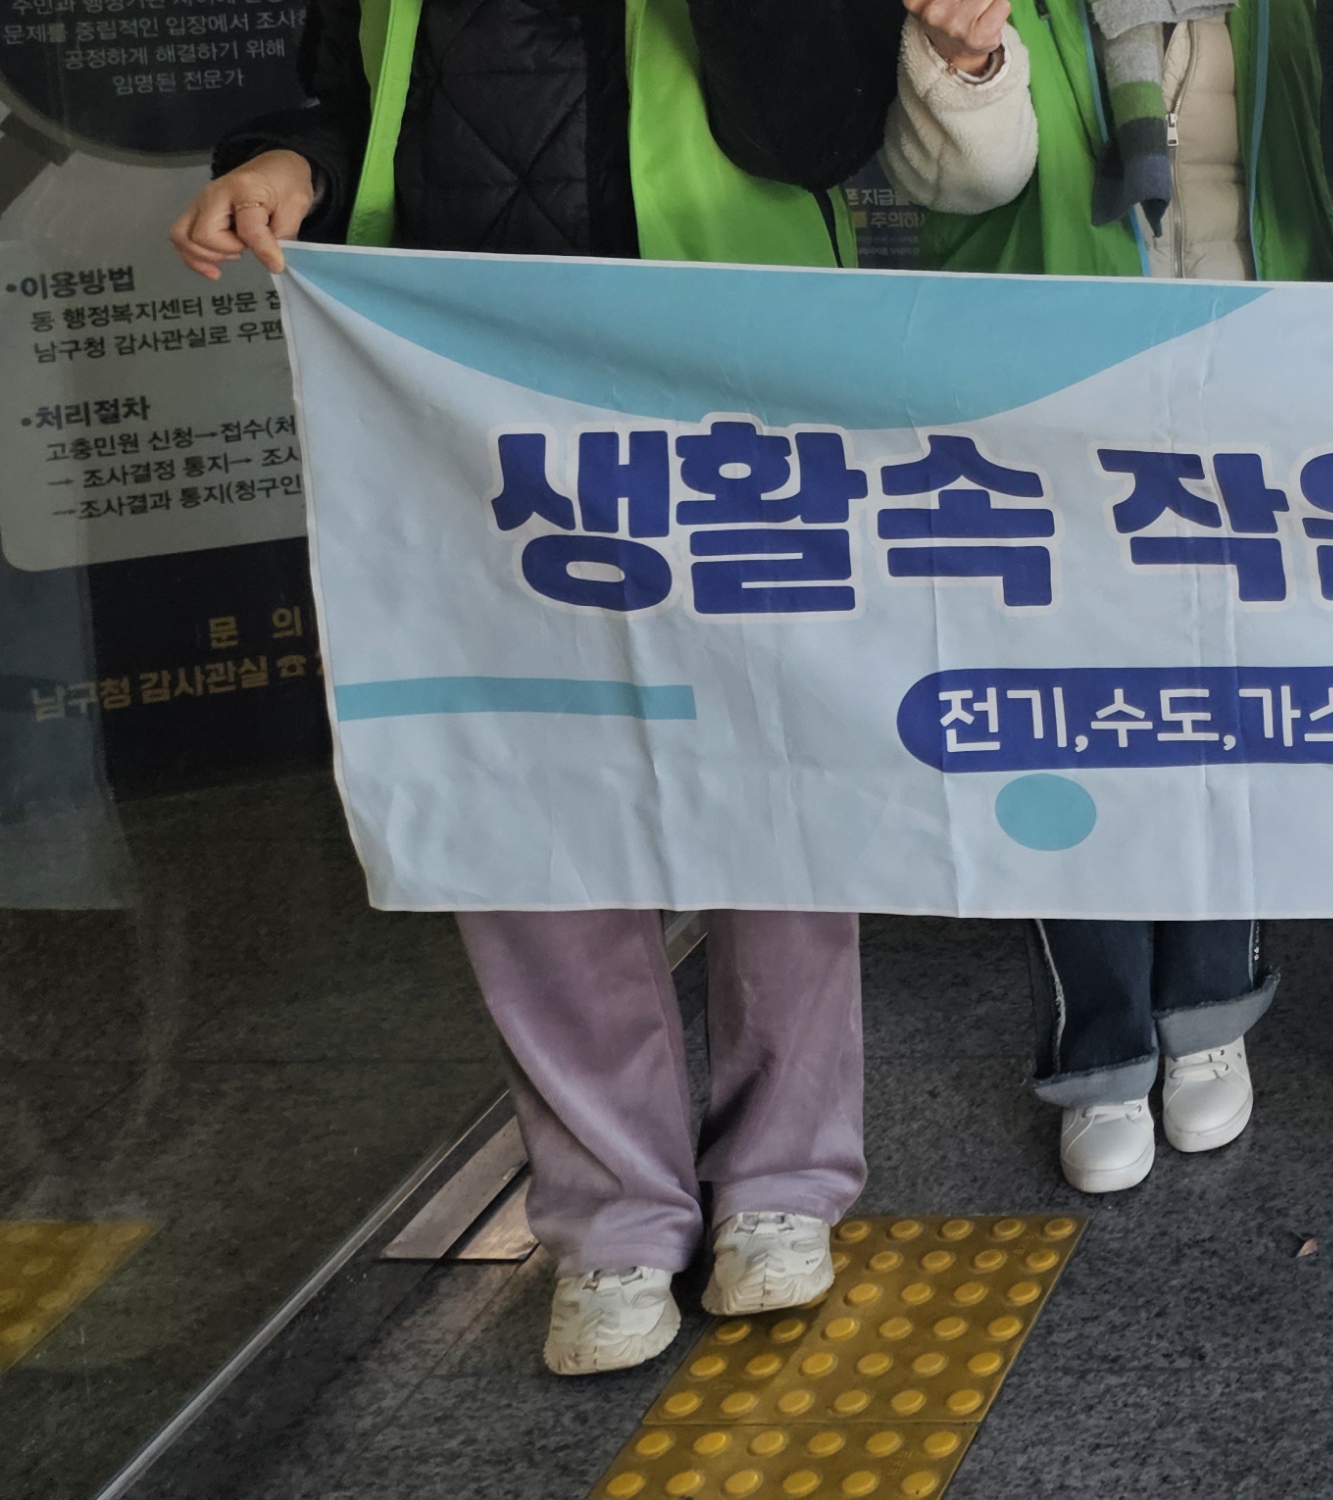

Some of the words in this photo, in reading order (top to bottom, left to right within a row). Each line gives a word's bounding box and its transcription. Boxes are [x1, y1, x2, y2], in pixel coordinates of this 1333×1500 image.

[75, 16, 159, 41] 중립적인
[165, 12, 250, 36] 입장에서
[64, 46, 149, 71] 공정하게
[155, 42, 239, 63] 해결하기
[246, 37, 285, 59] 위해
[111, 71, 177, 97] 임명된
[183, 67, 244, 91] 전문가
[20, 265, 136, 300] 이용방법
[29, 310, 56, 333] 동
[62, 295, 204, 328] 행정복지센터
[210, 290, 258, 317] 방문
[33, 336, 106, 364] 남구청
[113, 324, 232, 357] 감사관실로
[34, 395, 152, 431] 처리절차
[45, 431, 140, 462] 고충민원
[81, 459, 177, 490] 조사결정
[78, 489, 173, 521] 조사결과
[490, 421, 1056, 614] 생활속
[30, 677, 132, 723] 남구청
[138, 655, 271, 705] 감사관실
